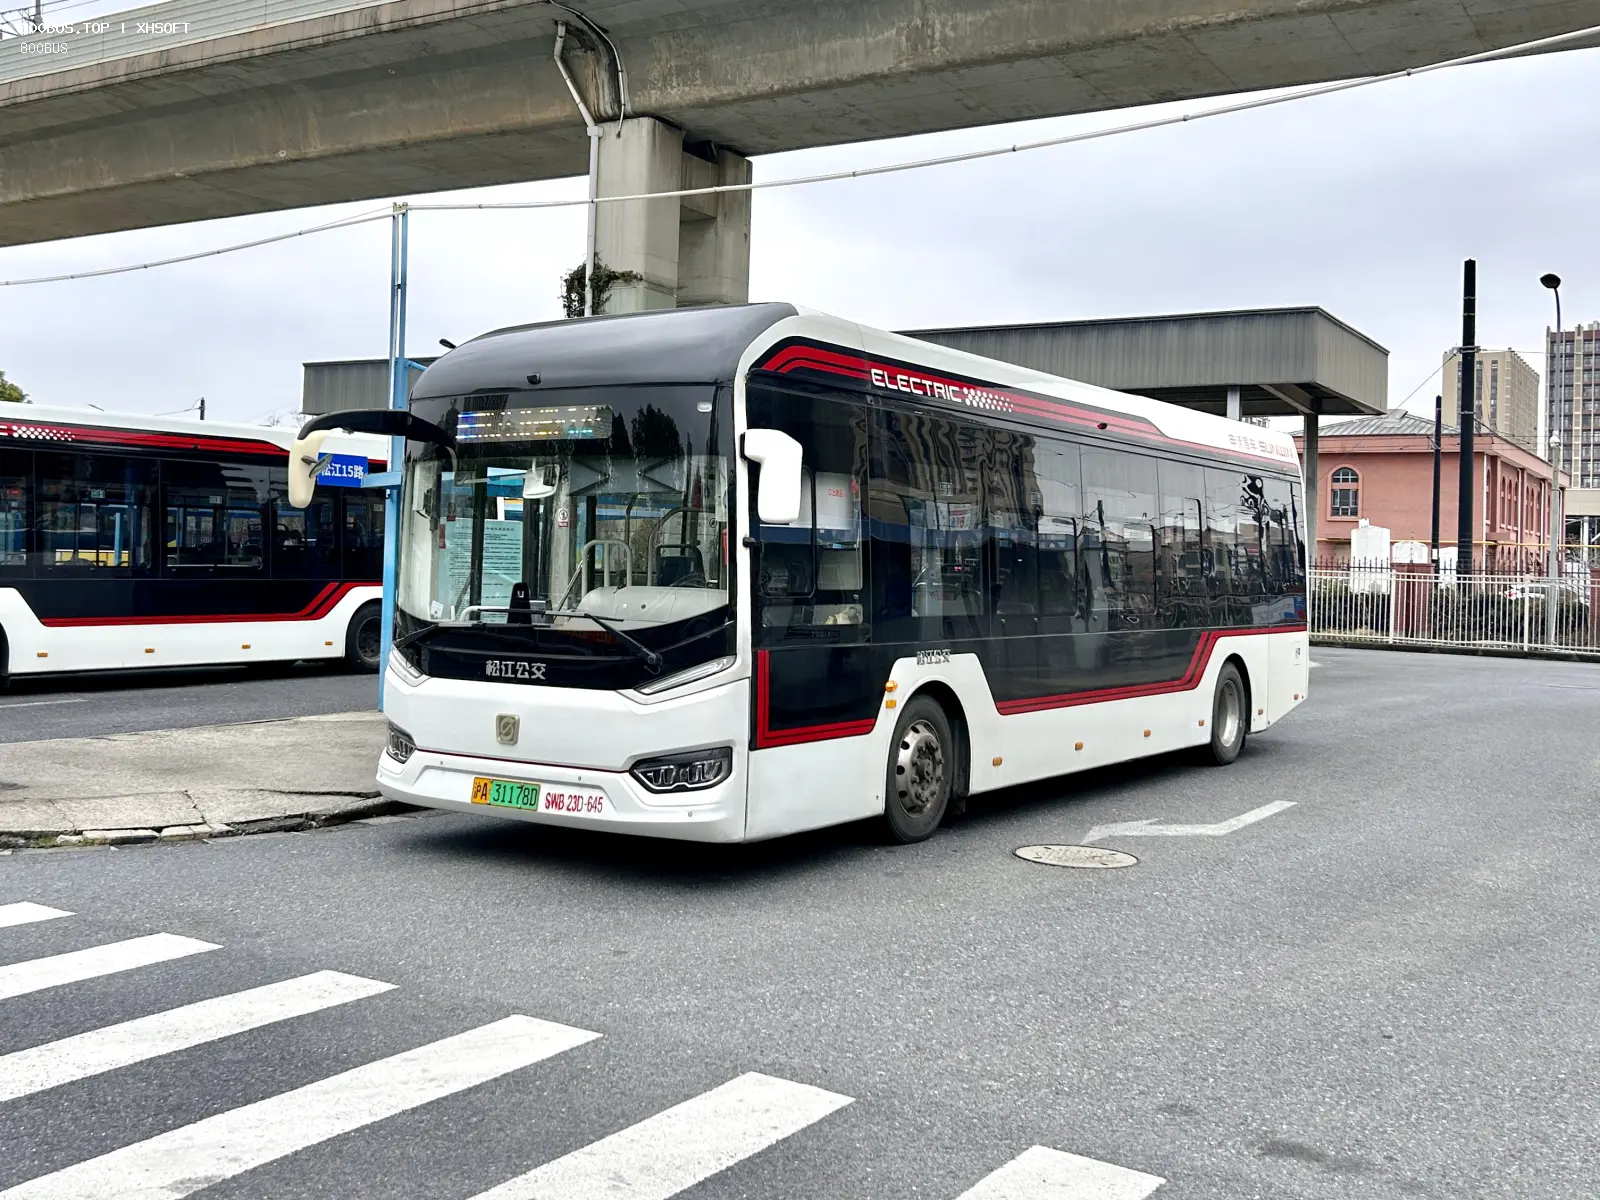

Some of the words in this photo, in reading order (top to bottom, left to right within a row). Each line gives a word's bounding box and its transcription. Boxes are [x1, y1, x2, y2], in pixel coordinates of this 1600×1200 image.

[870, 368, 962, 403] ELECTRIC
[485, 660, 546, 680] 松江公交
[545, 792, 564, 812] SWB
[566, 794, 604, 813] 23D-645
